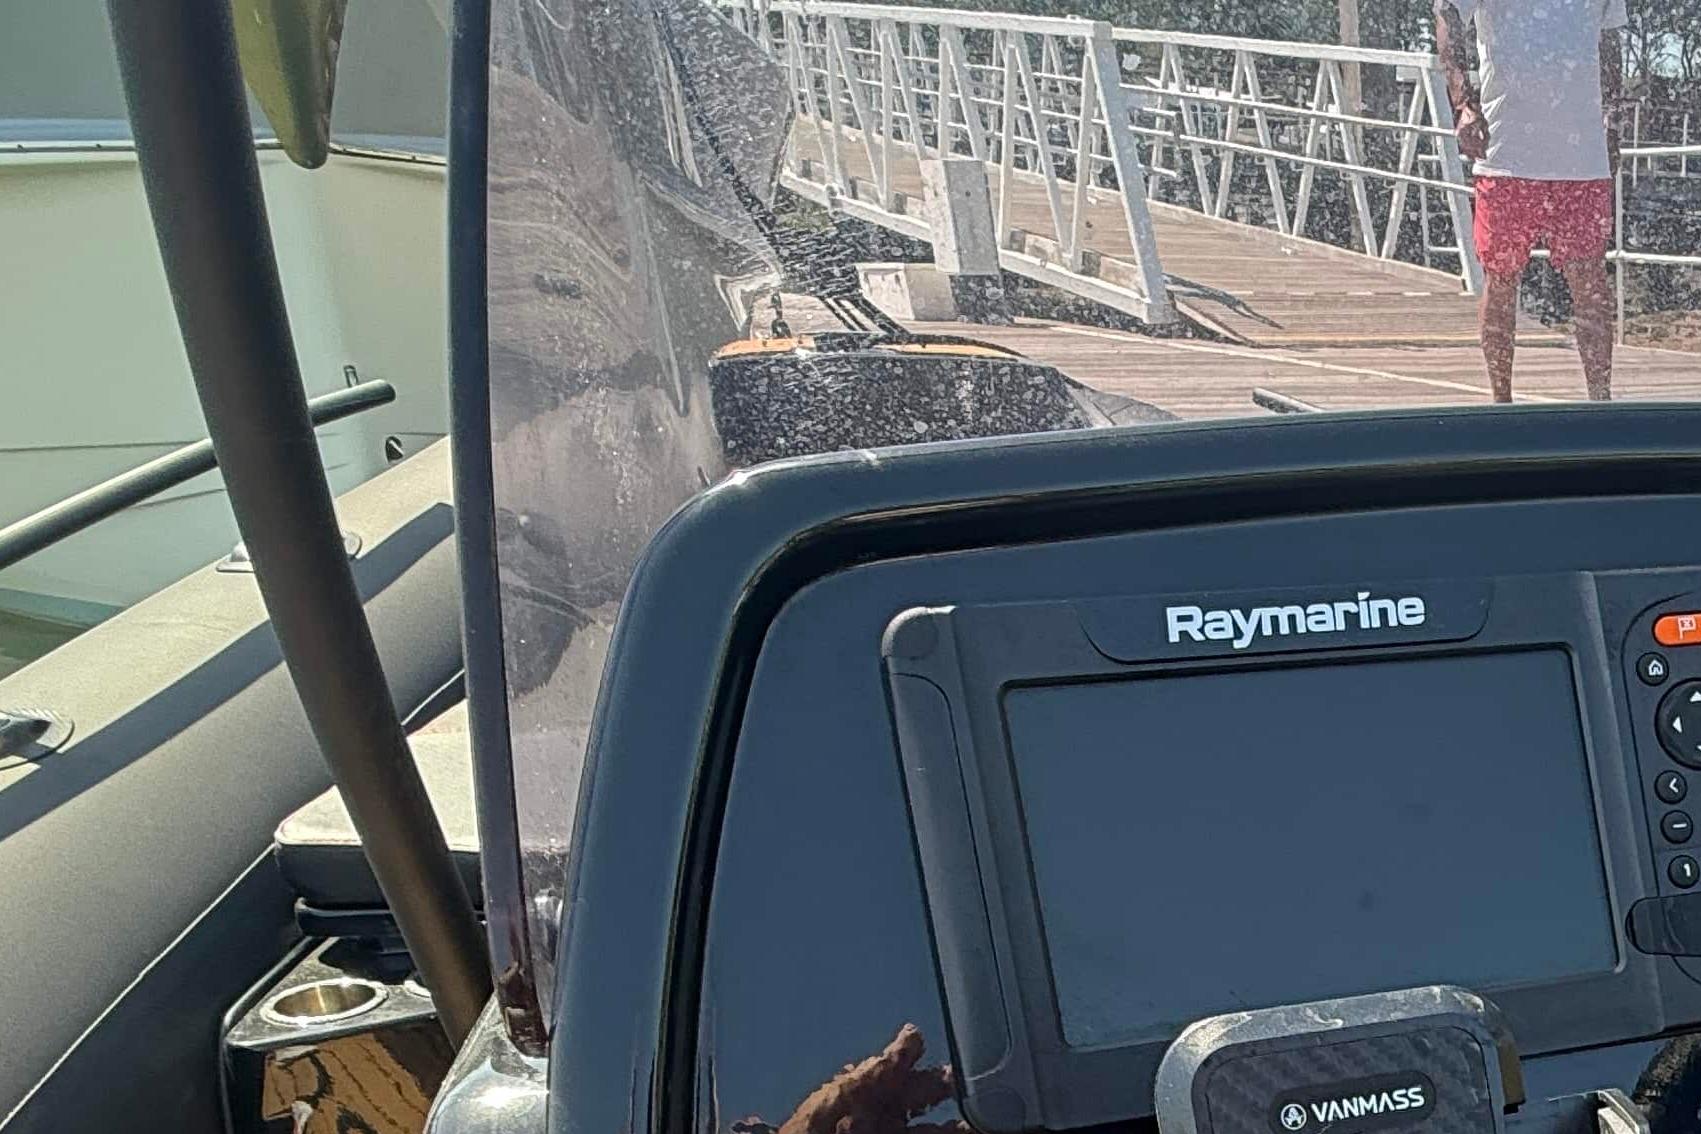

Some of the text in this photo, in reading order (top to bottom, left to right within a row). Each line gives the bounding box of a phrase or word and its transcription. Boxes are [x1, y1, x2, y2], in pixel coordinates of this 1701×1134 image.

[1165, 591, 1426, 650] Raymarine
[1683, 863, 1691, 877] 1
[1310, 1087, 1425, 1123] VANMASS
